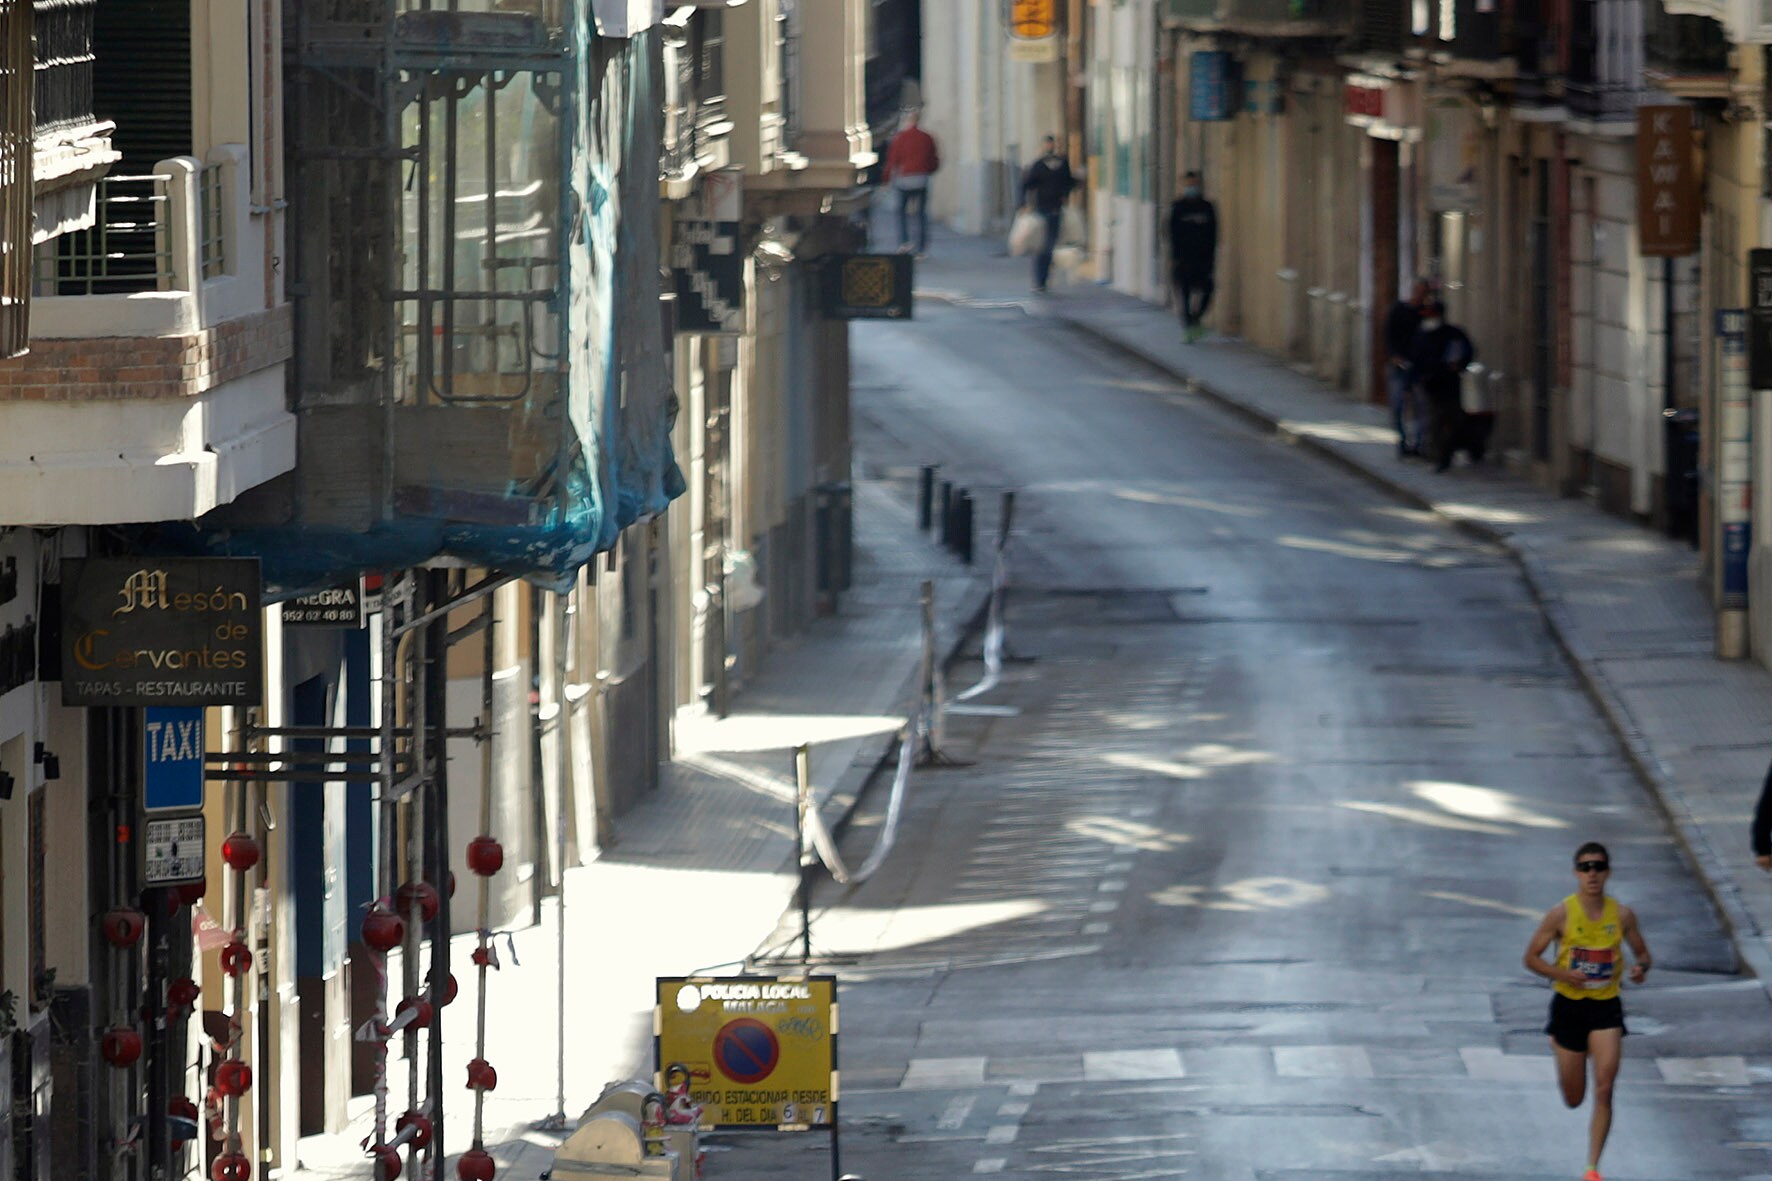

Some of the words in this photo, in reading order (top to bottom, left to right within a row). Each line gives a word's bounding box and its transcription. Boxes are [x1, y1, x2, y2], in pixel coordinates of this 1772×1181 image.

[112, 569, 248, 617] Mesón
[215, 620, 248, 640] de
[74, 630, 247, 670] Cervantes
[76, 682, 122, 696] TAPAS
[136, 681, 247, 696] RESTAURANTE
[147, 720, 201, 762] TAXI
[701, 984, 760, 1000] POLICIA
[762, 983, 811, 999] LOCAL
[725, 1090, 788, 1104] ESTACIONAR
[792, 1090, 827, 1104] DESDE
[736, 1108, 756, 1121] DEL
